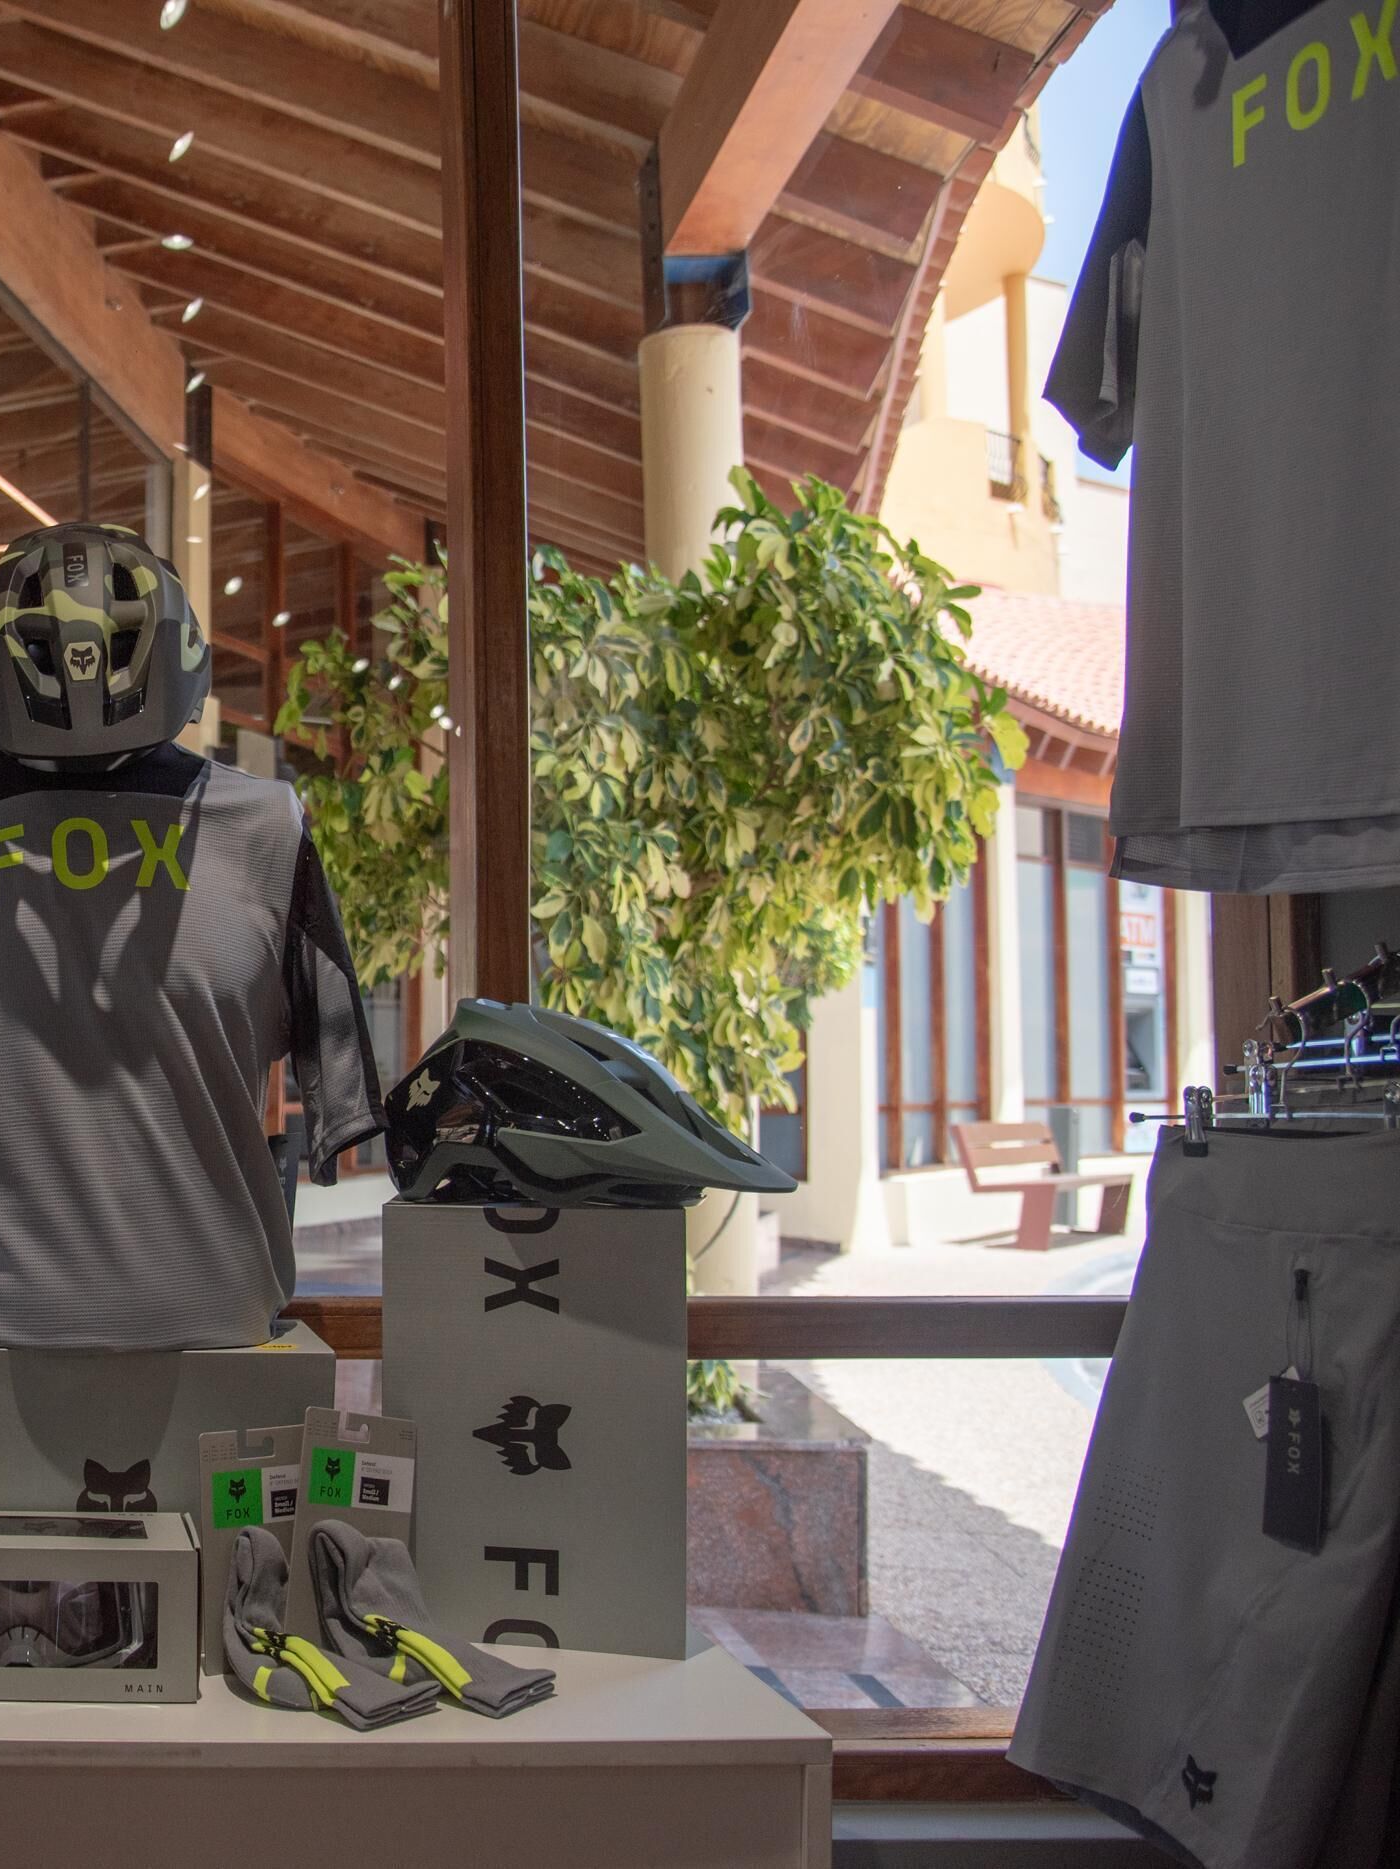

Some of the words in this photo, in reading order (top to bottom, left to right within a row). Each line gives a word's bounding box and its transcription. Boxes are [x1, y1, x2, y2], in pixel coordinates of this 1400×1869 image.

[1232, 0, 1399, 168] FOX
[65, 554, 86, 583] FOX
[1287, 1432, 1301, 1474] FOX
[319, 1486, 341, 1498] FOX
[226, 1507, 250, 1521] FOX
[124, 1684, 163, 1693] MAIN
